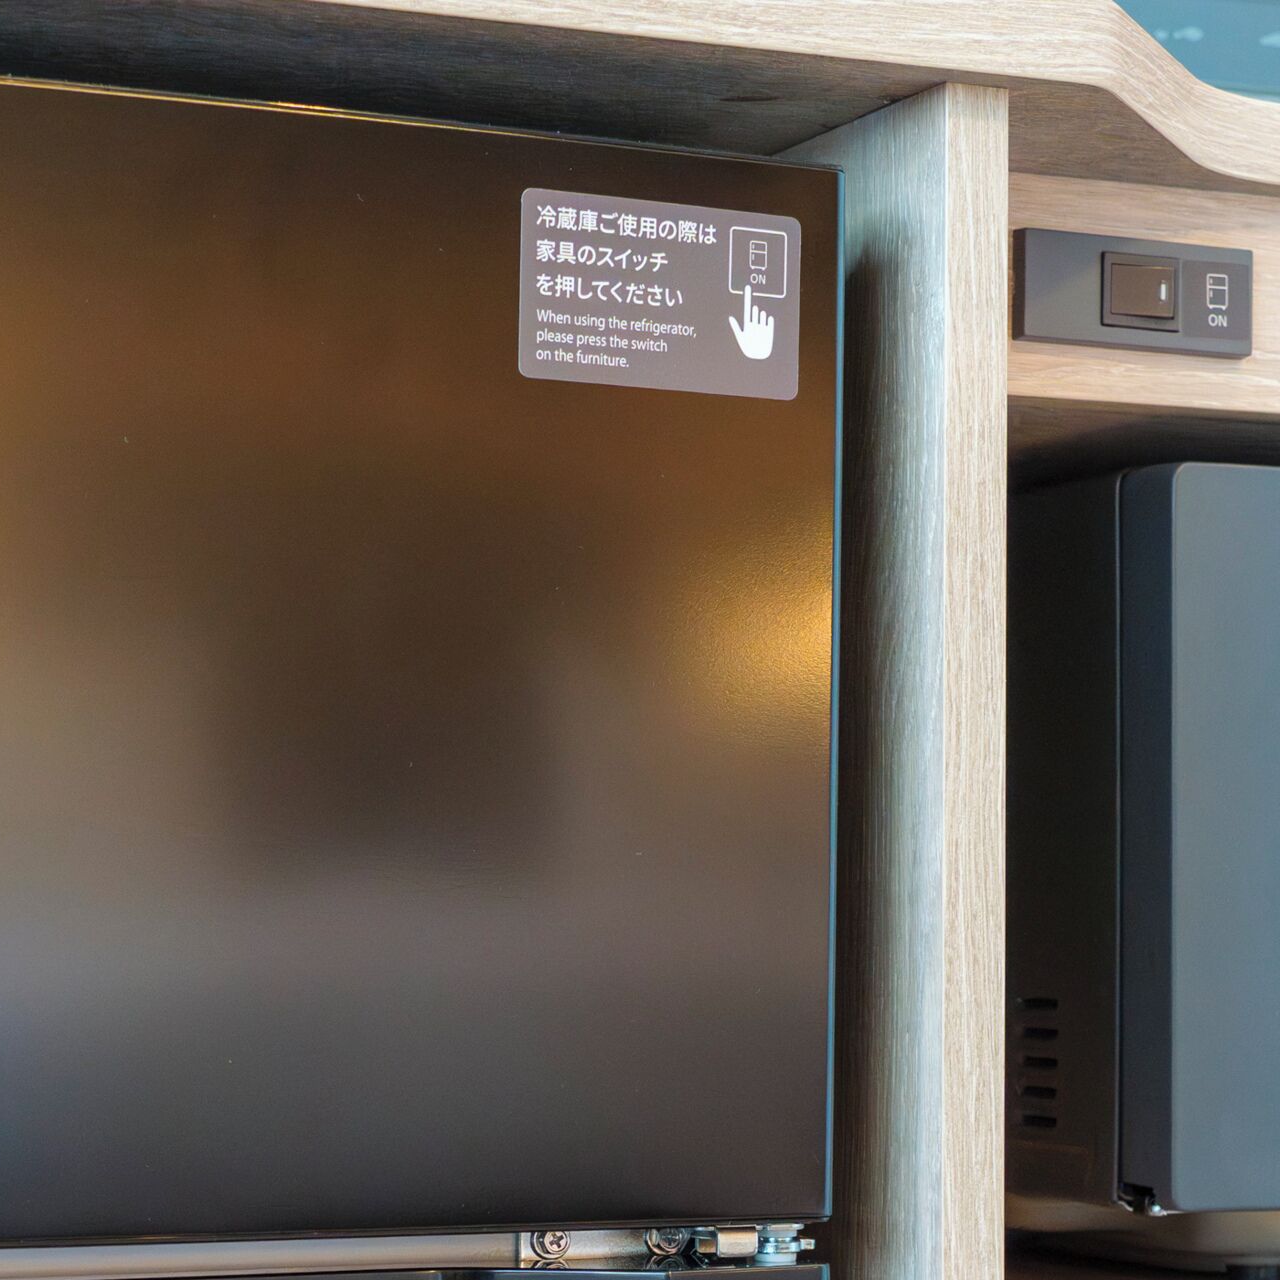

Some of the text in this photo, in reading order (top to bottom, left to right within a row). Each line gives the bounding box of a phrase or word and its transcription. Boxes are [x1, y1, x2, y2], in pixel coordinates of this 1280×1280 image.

[536, 205, 717, 245] 冷蔵庫ご使用の際は
[535, 238, 668, 273] 家具のスイッチ
[535, 273, 683, 306] を押してください
[750, 274, 766, 286] ON
[536, 309, 697, 338] When using the refrigerator,
[1207, 313, 1228, 328] ON
[536, 330, 668, 352] please press the switch
[536, 349, 630, 368] on the furniture.
